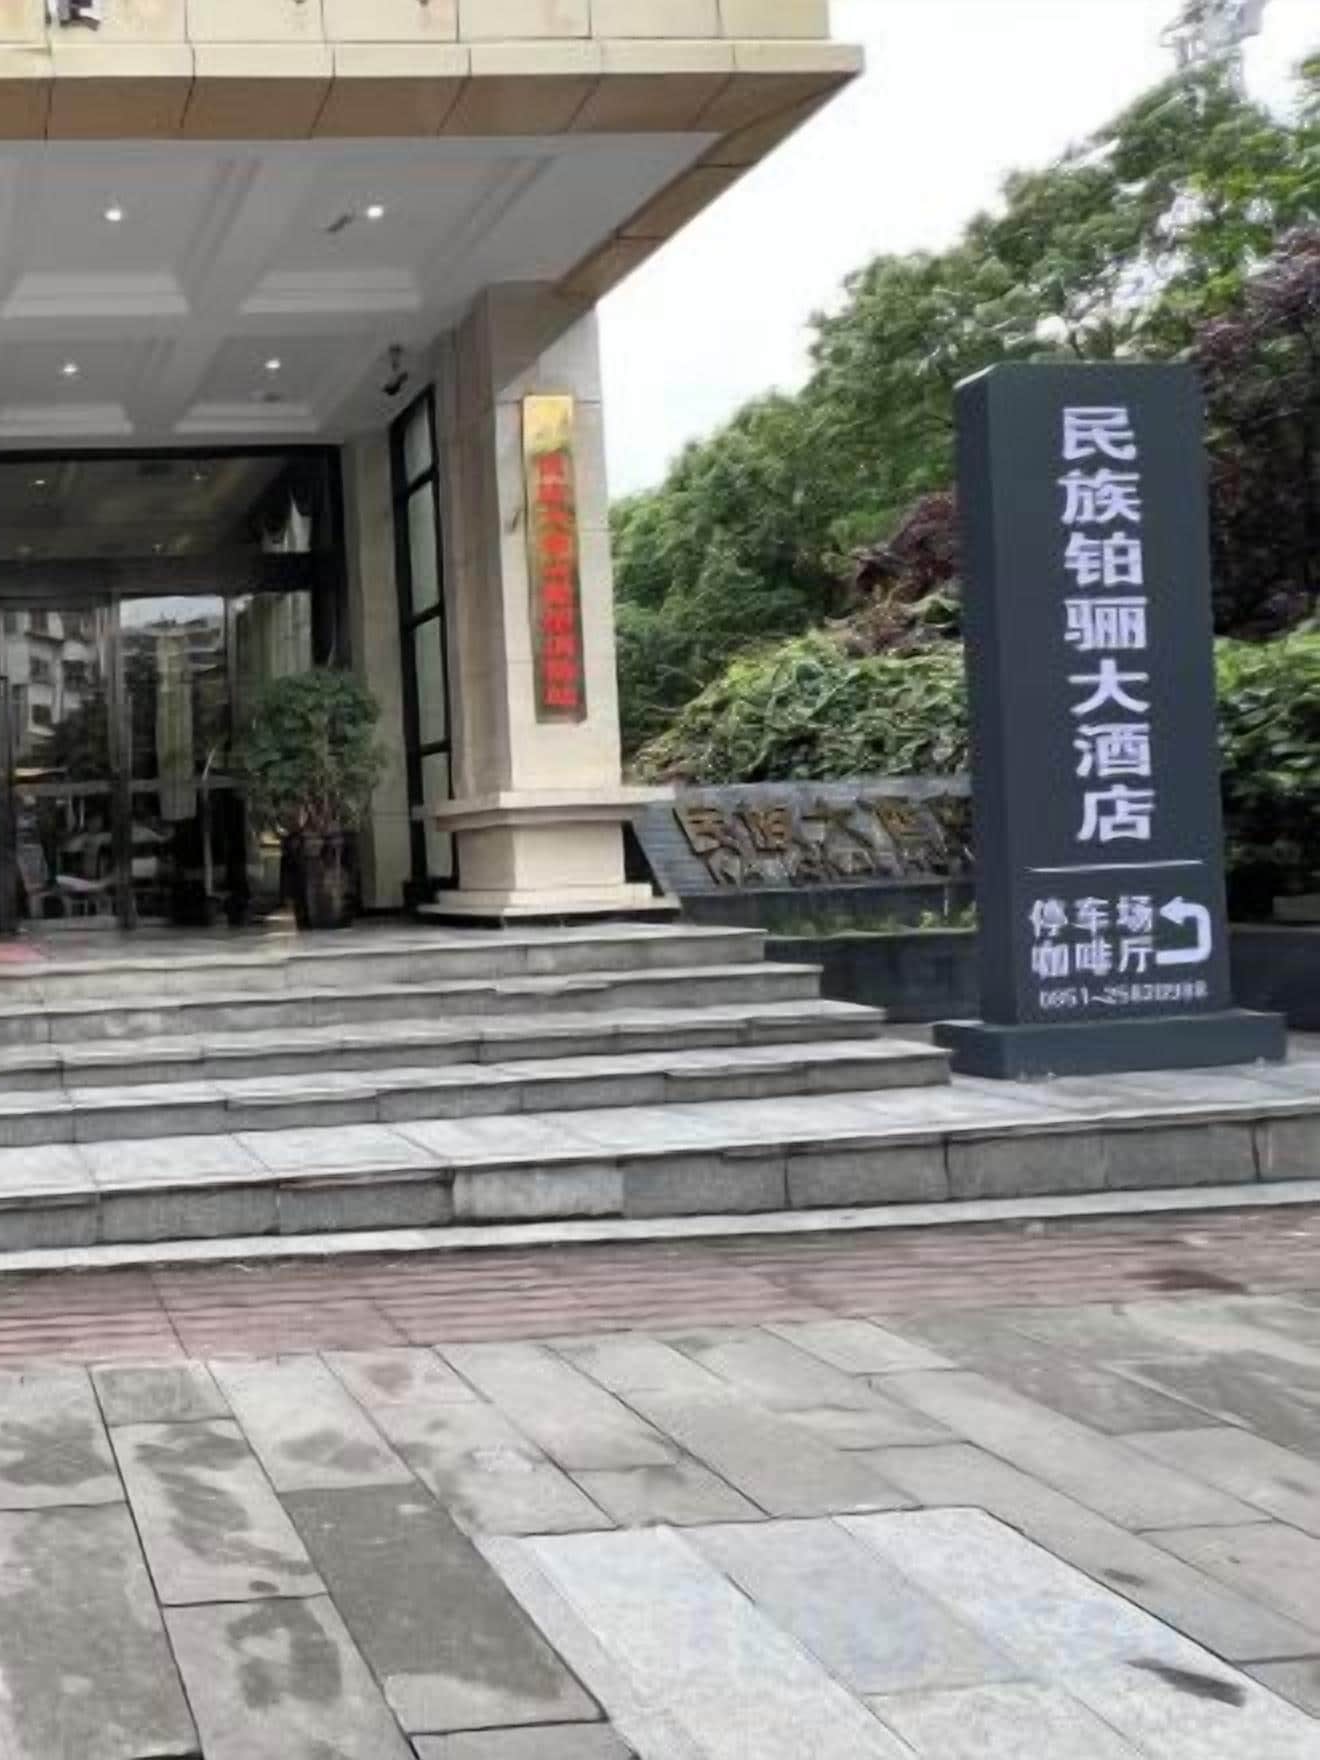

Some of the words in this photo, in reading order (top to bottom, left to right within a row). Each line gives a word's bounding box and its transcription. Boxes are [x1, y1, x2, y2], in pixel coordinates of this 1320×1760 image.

[1057, 406, 1156, 842] 民族铂骊大酒店
